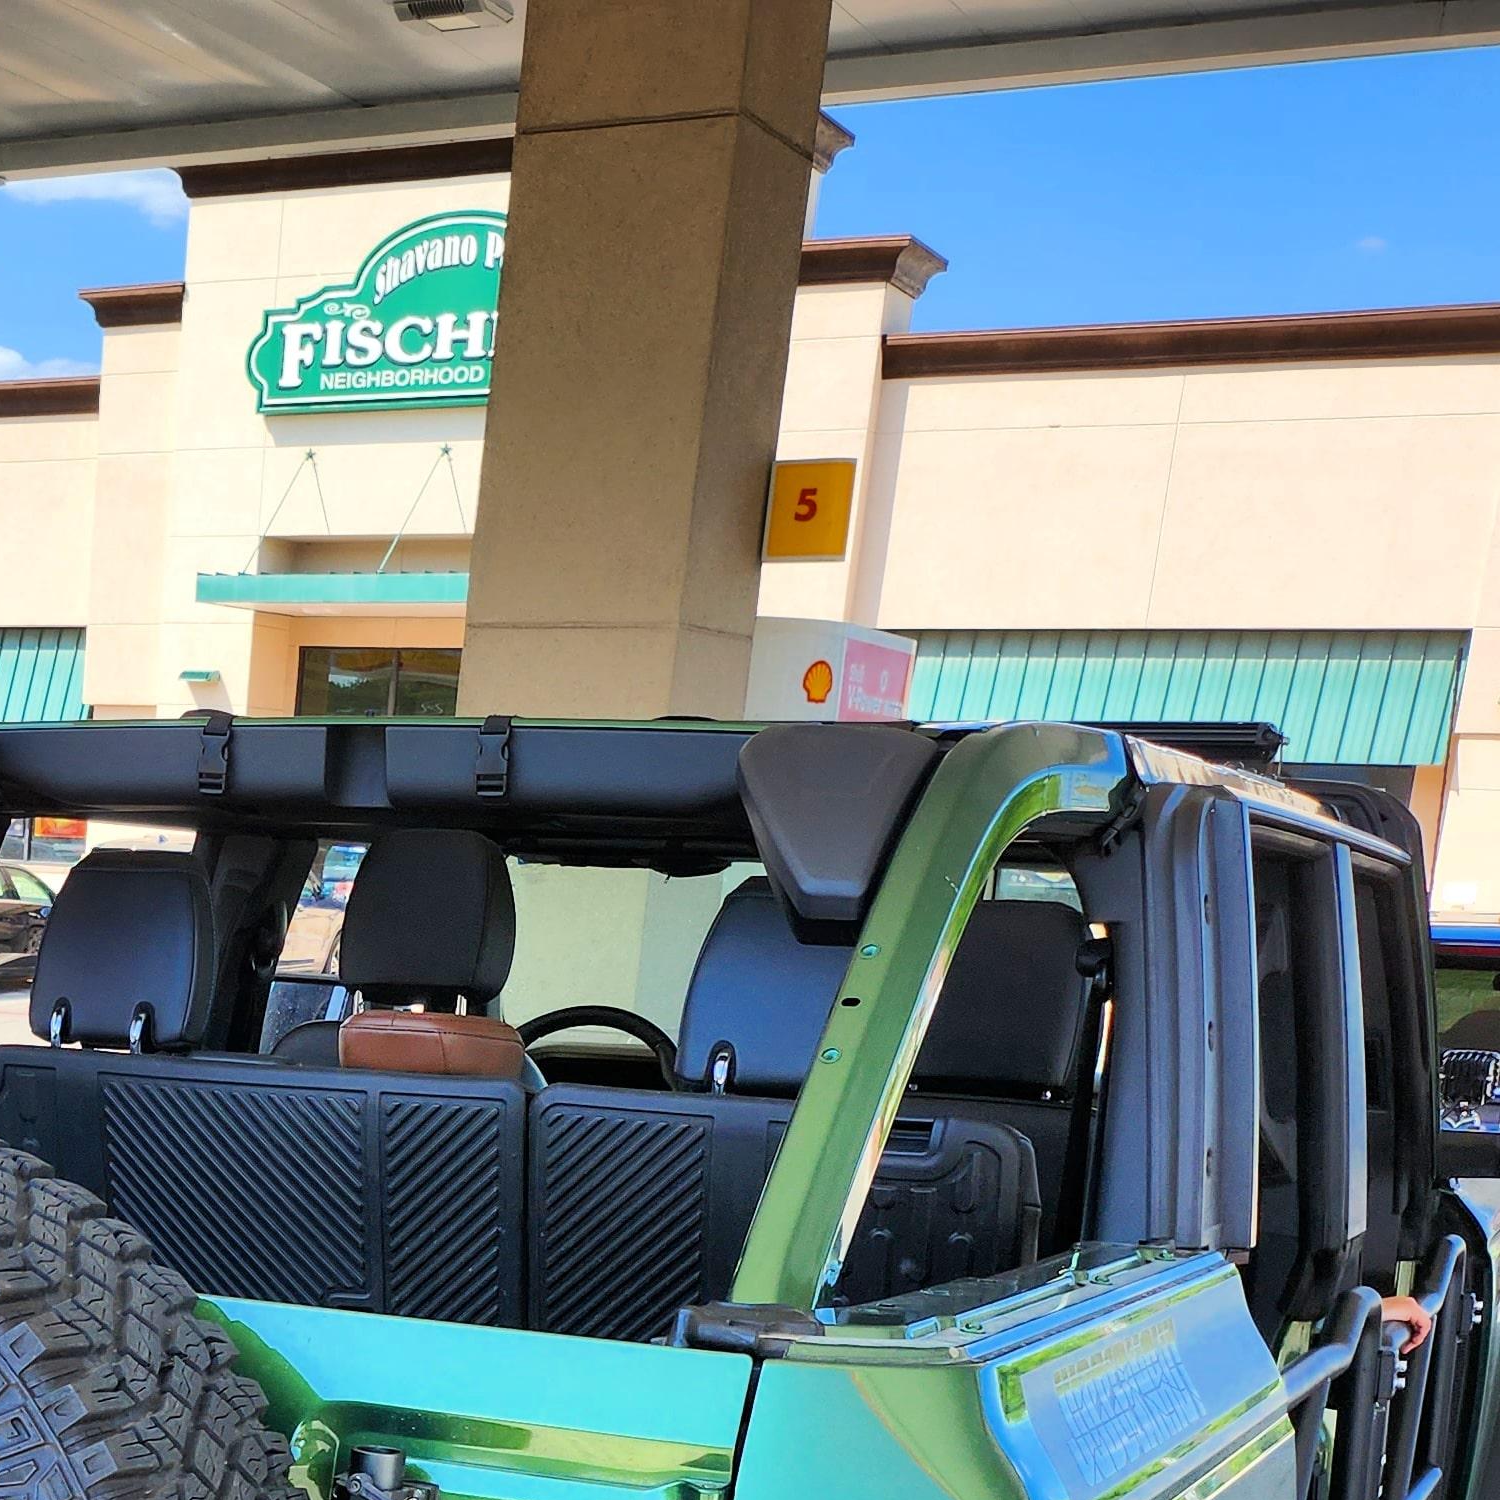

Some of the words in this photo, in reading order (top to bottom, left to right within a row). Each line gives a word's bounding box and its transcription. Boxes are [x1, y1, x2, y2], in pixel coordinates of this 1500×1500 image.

[373, 234, 479, 305] Shavano
[278, 310, 498, 390] FISCH
[320, 365, 485, 391] NEIGHBORHOOD
[794, 488, 818, 522] 5
